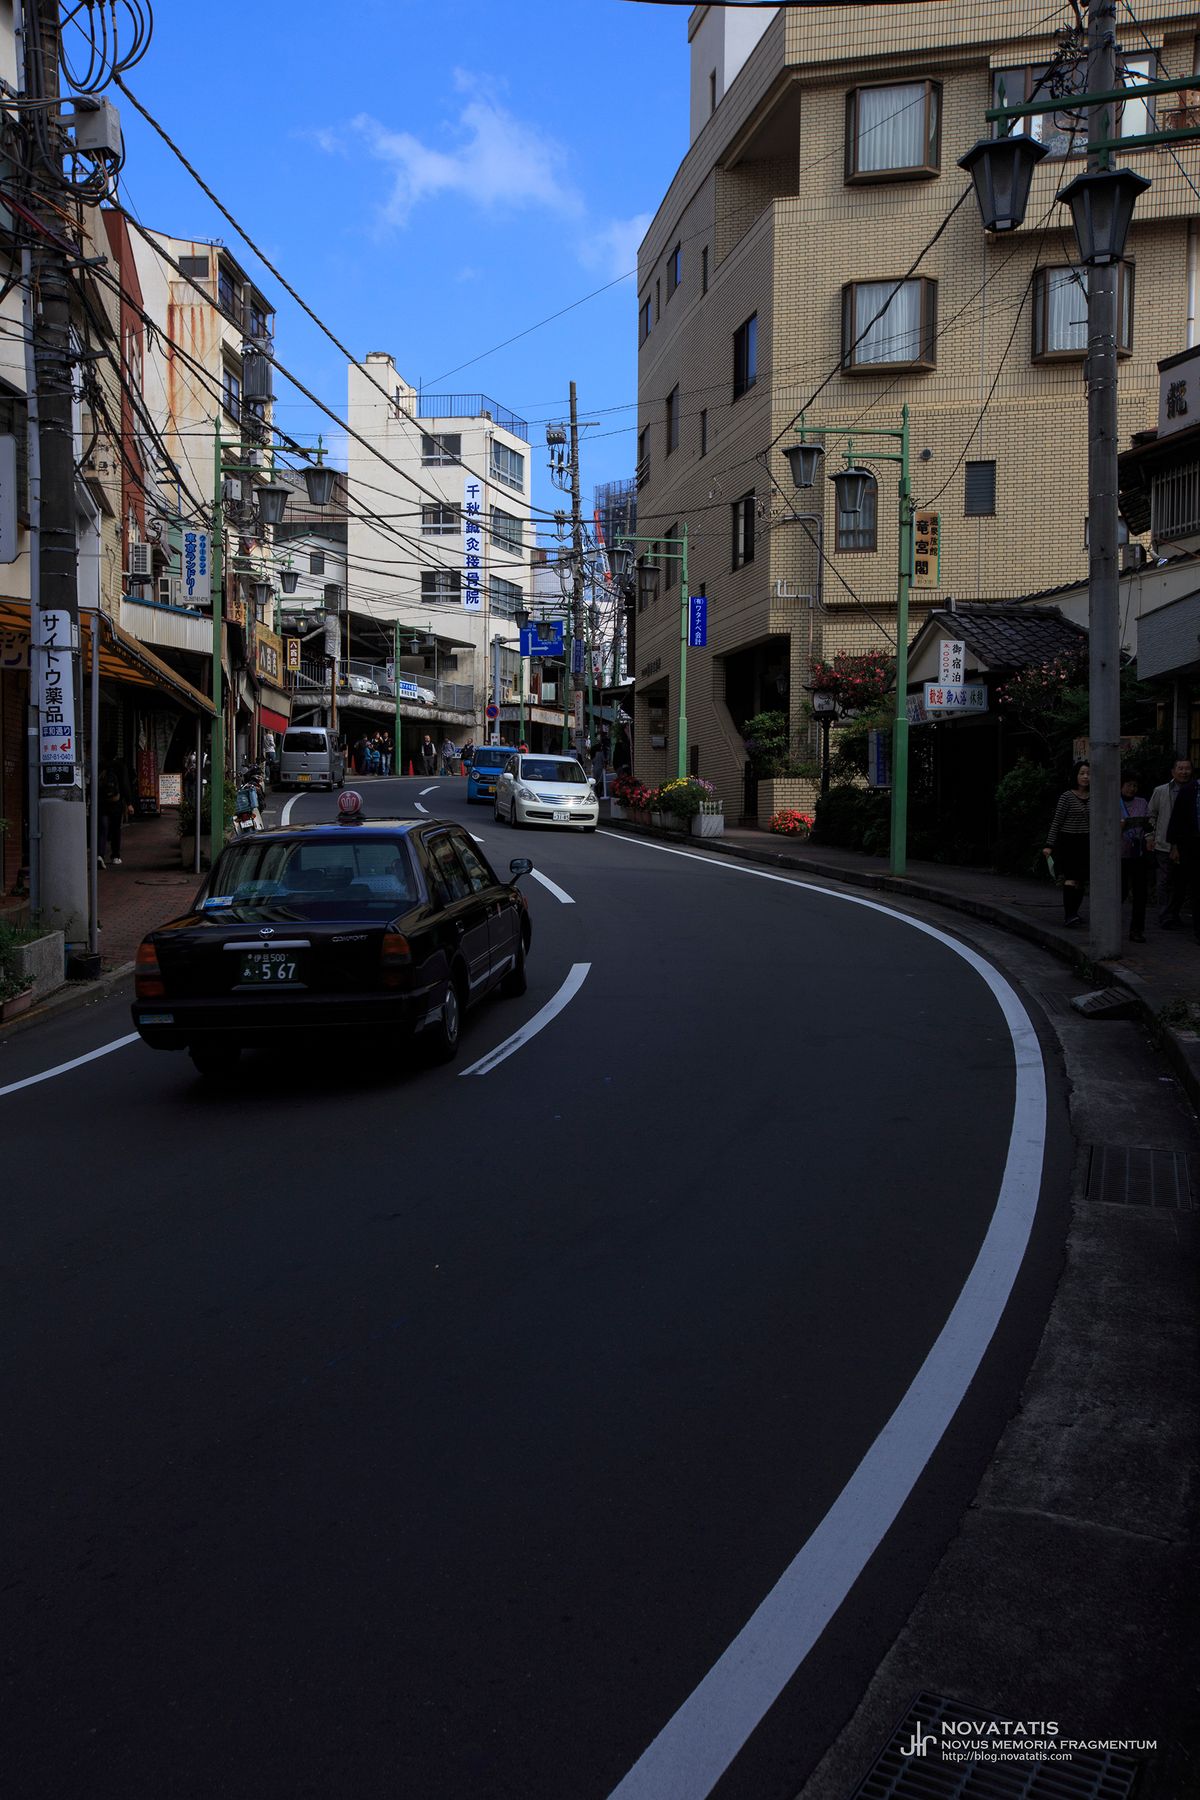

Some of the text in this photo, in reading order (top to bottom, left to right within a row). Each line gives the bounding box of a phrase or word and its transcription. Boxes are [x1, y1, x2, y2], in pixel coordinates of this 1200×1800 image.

[185, 533, 196, 595] 東京ランドリー
[43, 614, 63, 723] サイトウ薬品
